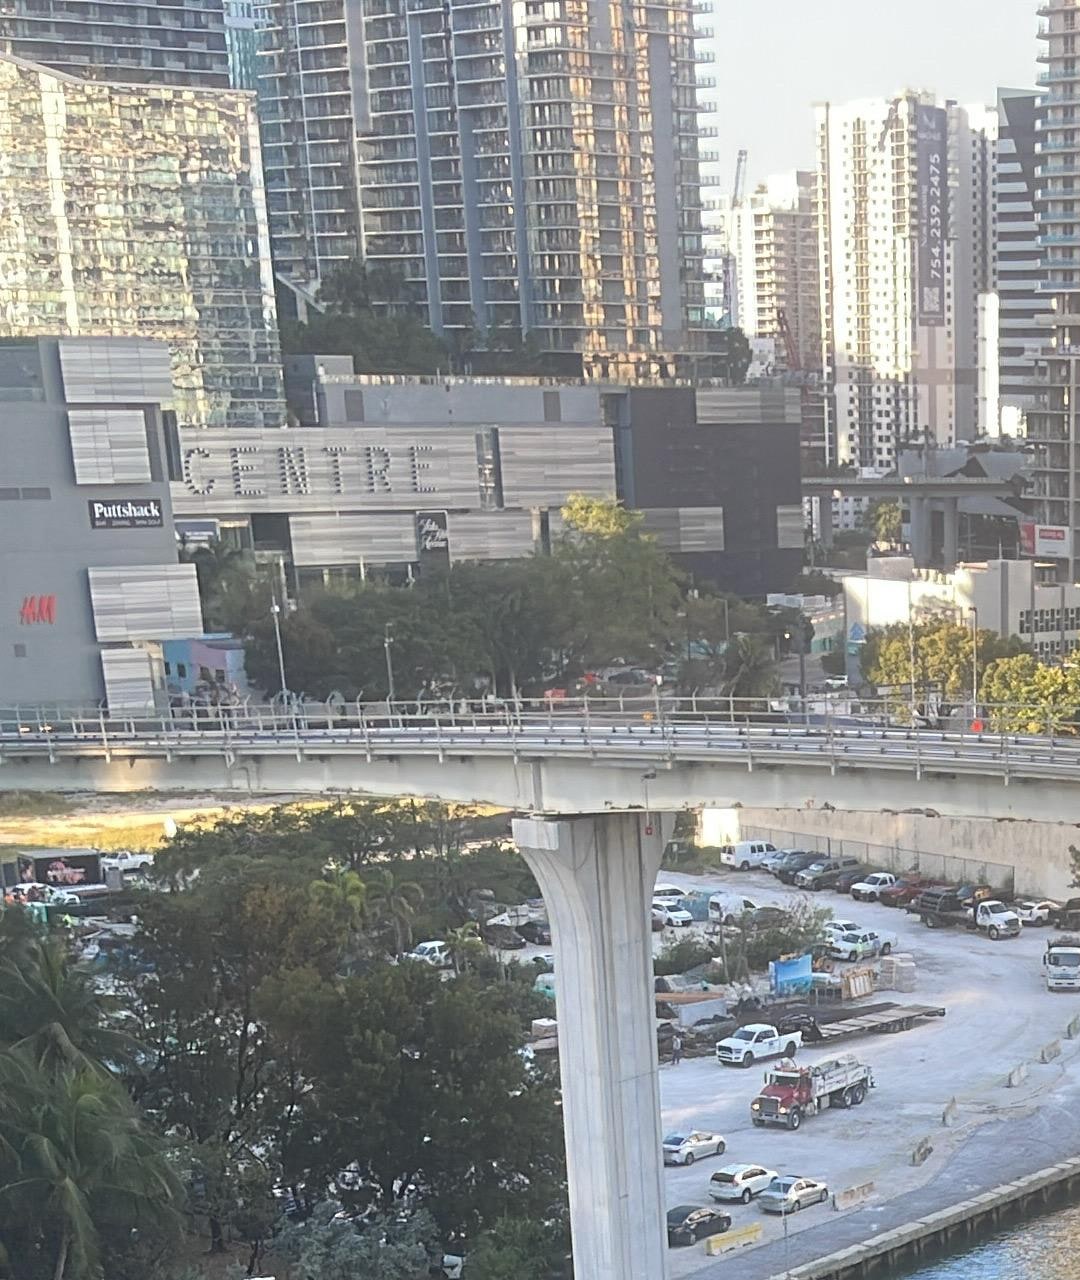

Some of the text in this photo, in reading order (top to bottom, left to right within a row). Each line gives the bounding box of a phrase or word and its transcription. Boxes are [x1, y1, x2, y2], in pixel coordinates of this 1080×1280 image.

[930, 153, 941, 279] 754.239.2475
[183, 446, 438, 496] CENTRE
[93, 501, 160, 518] Puttshack
